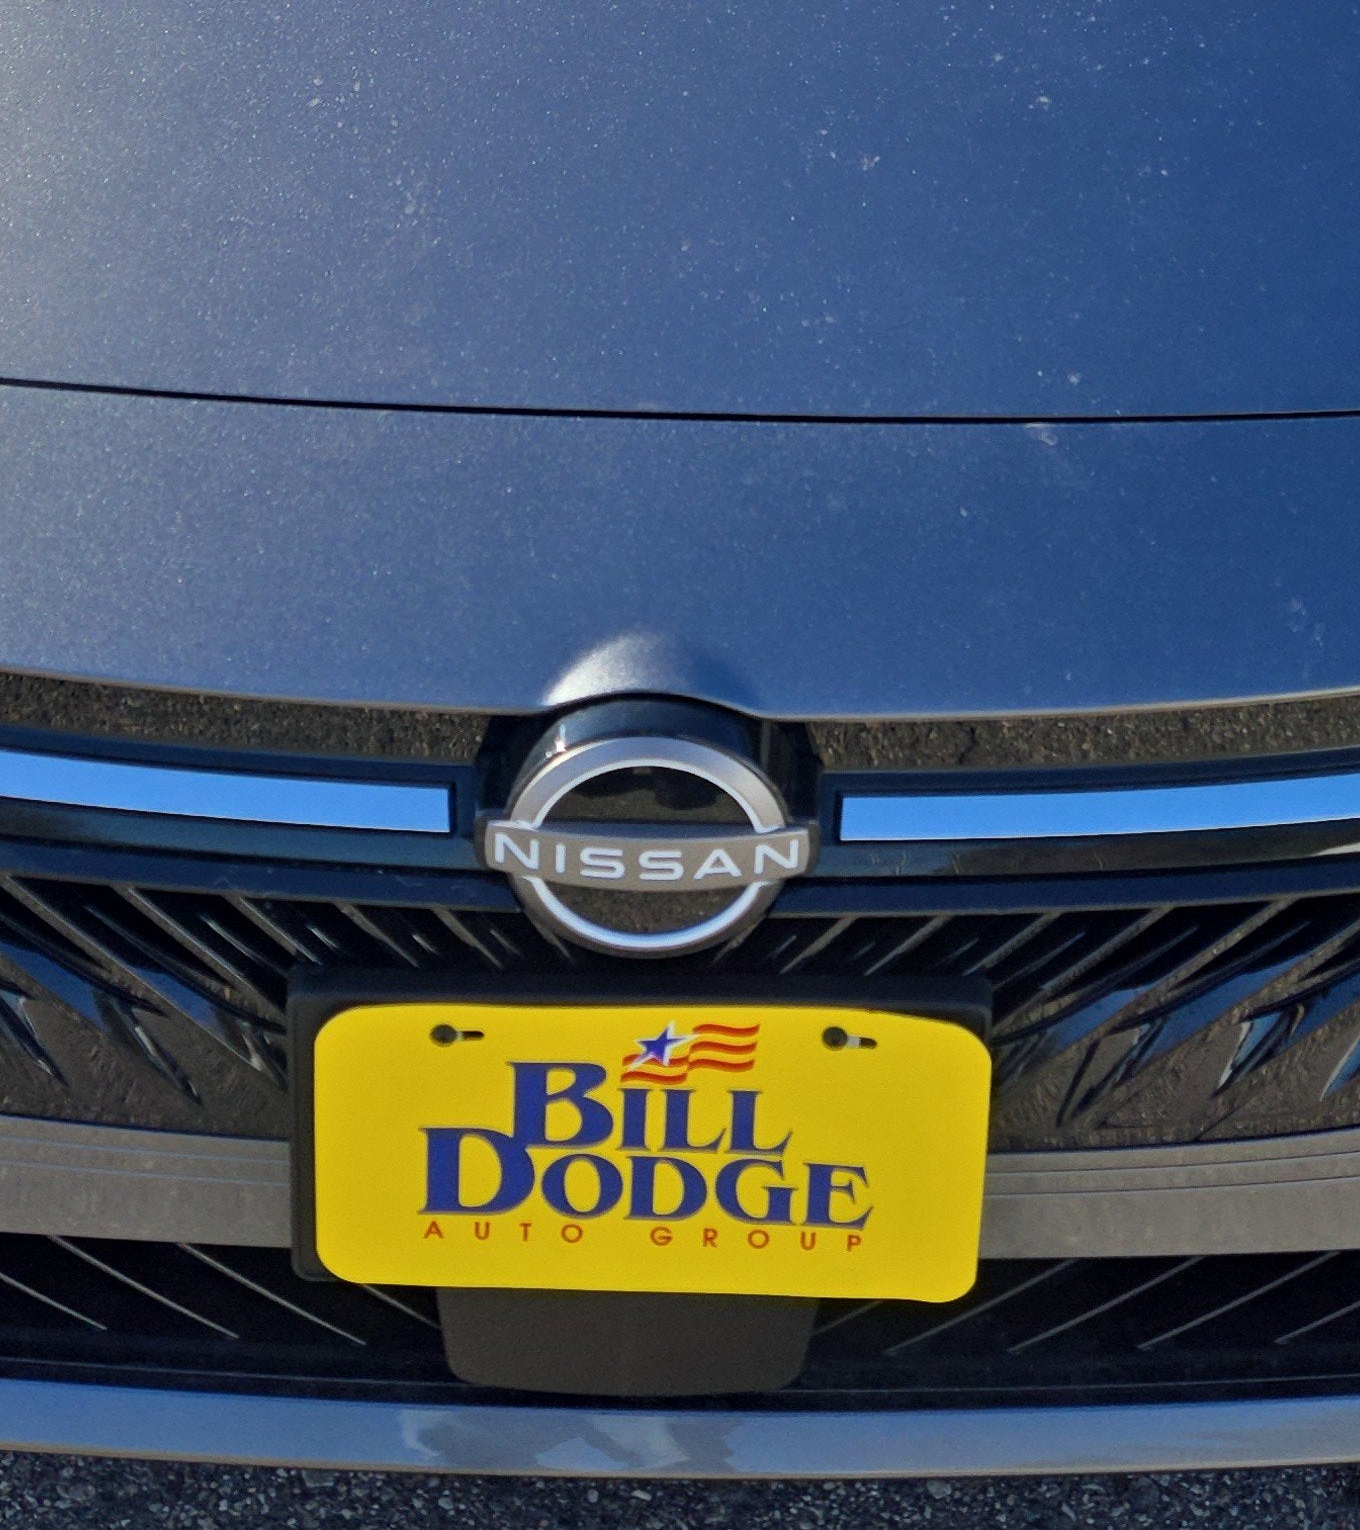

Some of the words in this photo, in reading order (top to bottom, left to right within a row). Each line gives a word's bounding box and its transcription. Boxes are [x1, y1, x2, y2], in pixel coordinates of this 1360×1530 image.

[494, 833, 799, 881] NISSAN
[505, 1060, 794, 1156] BILL
[417, 1126, 874, 1228] DODGE
[423, 1220, 584, 1245] AUTO
[650, 1225, 862, 1253] GROUP
